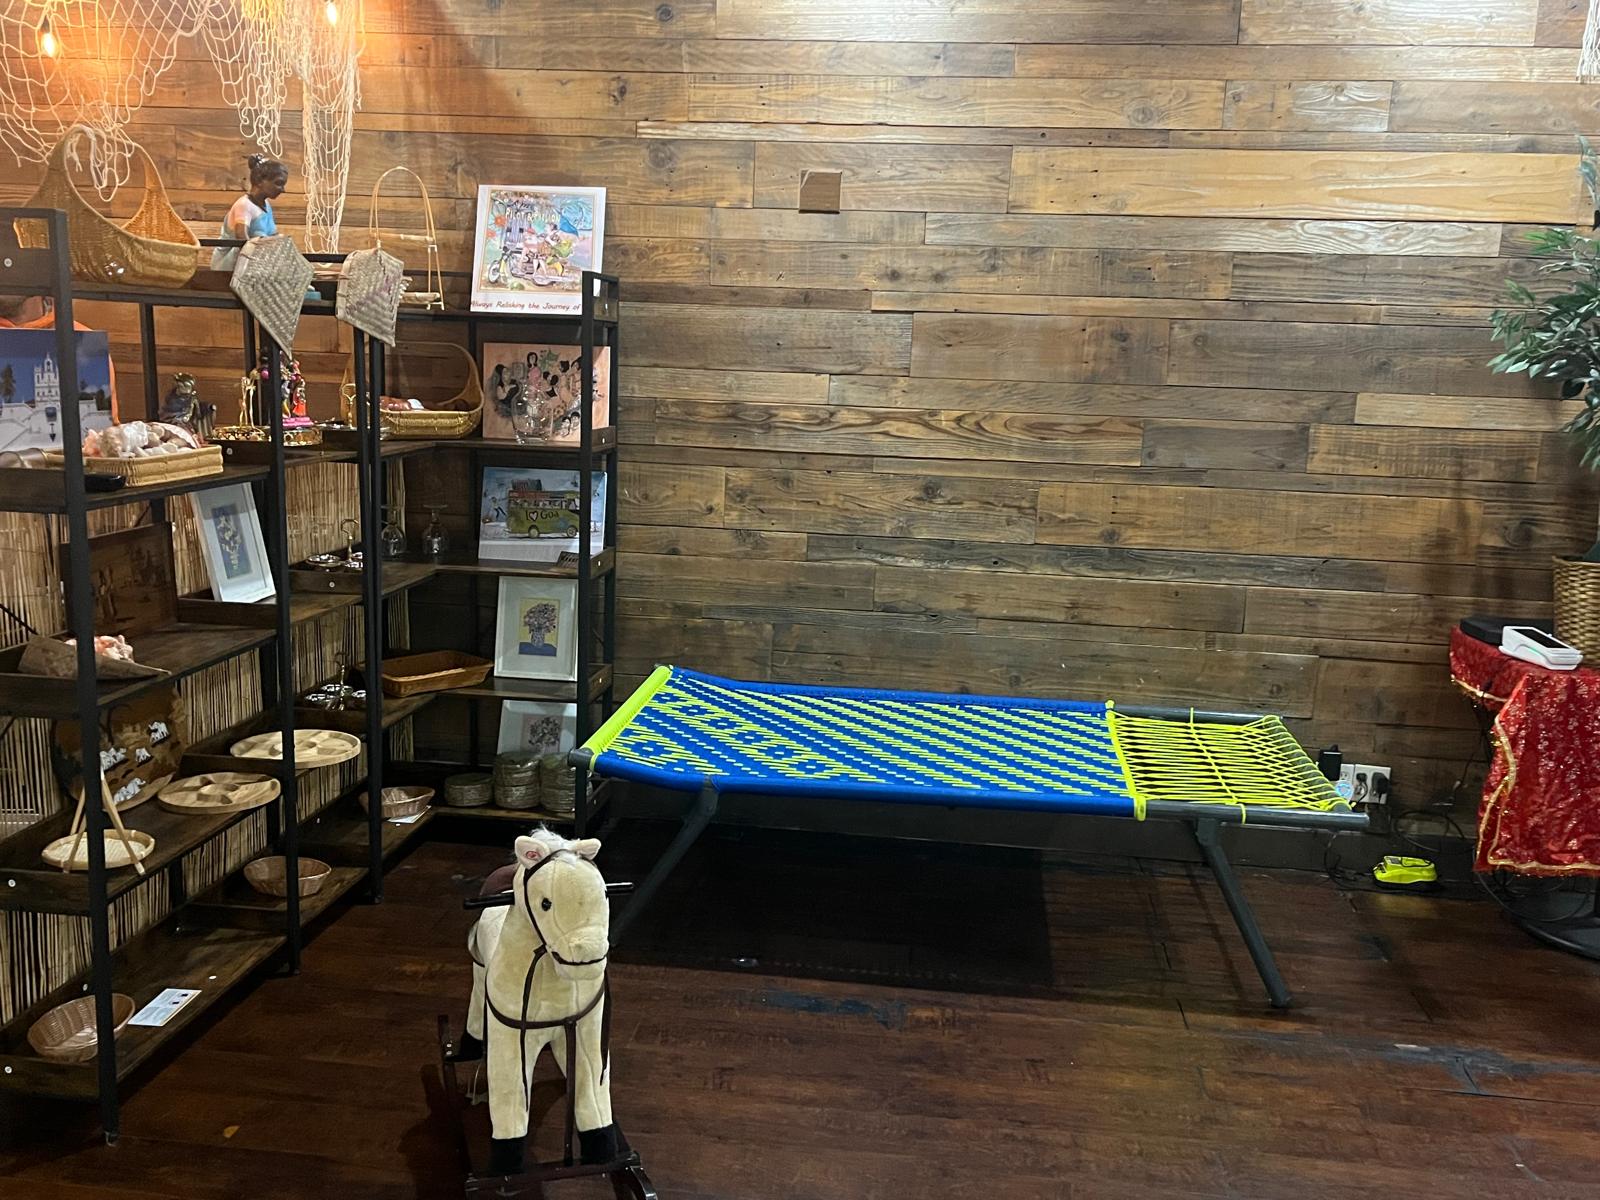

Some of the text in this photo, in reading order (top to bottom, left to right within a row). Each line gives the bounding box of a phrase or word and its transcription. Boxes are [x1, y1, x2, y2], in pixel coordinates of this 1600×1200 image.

[505, 207, 525, 220] PILOT
[543, 303, 570, 311] Journey
[540, 511, 560, 520] Goa
